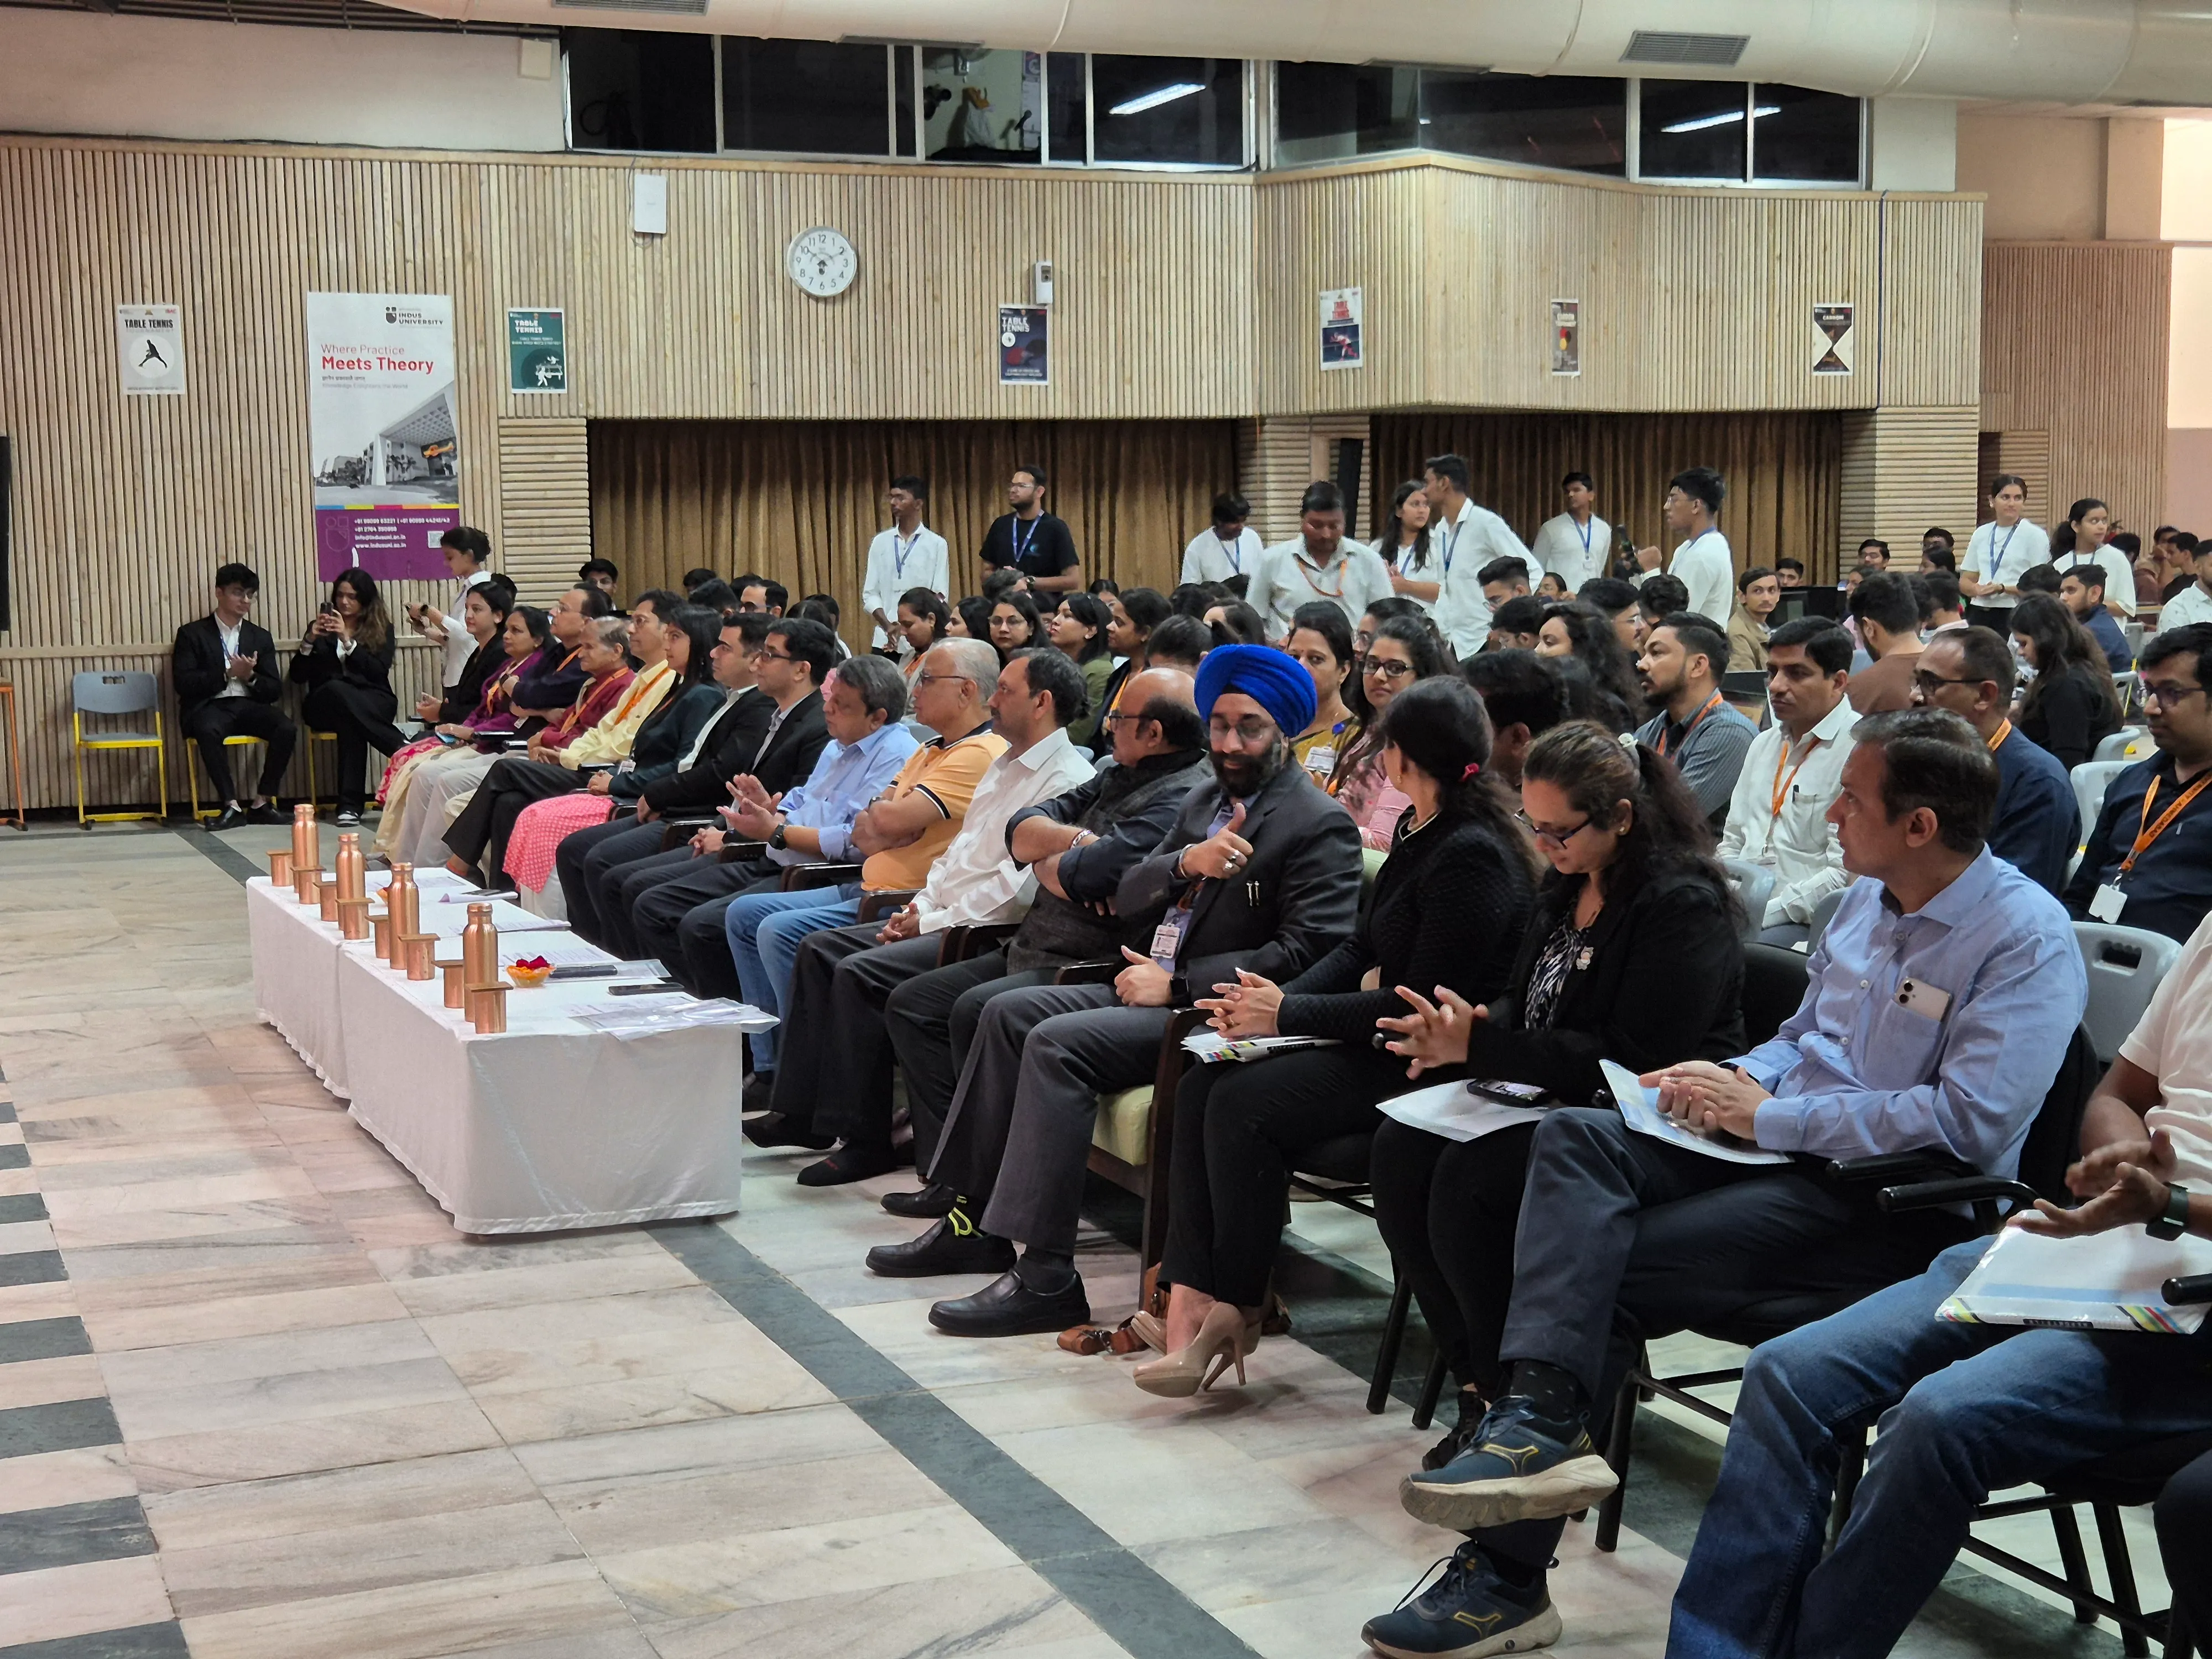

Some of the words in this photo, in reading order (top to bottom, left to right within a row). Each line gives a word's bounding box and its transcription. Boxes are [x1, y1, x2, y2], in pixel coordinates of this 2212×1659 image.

[808, 237, 816, 247] 11
[818, 234, 827, 244] 12
[800, 246, 809, 255] 10
[839, 247, 845, 255] 2
[796, 257, 801, 265] 9
[843, 259, 848, 268] 3
[800, 268, 805, 278] 8
[839, 270, 844, 279] 4
[808, 277, 814, 286] 7
[820, 281, 825, 290] 6
[831, 279, 836, 288] 5
[124, 319, 146, 328] TABLE
[148, 319, 174, 328] TENNIS
[1002, 317, 1027, 325] TABLE
[1002, 324, 1030, 332] TENNIS
[321, 345, 357, 354] Where
[360, 345, 405, 355] Practice
[322, 356, 372, 371] Meets
[376, 357, 434, 374] Theory
[2149, 801, 2182, 838] AHMEDABAD
